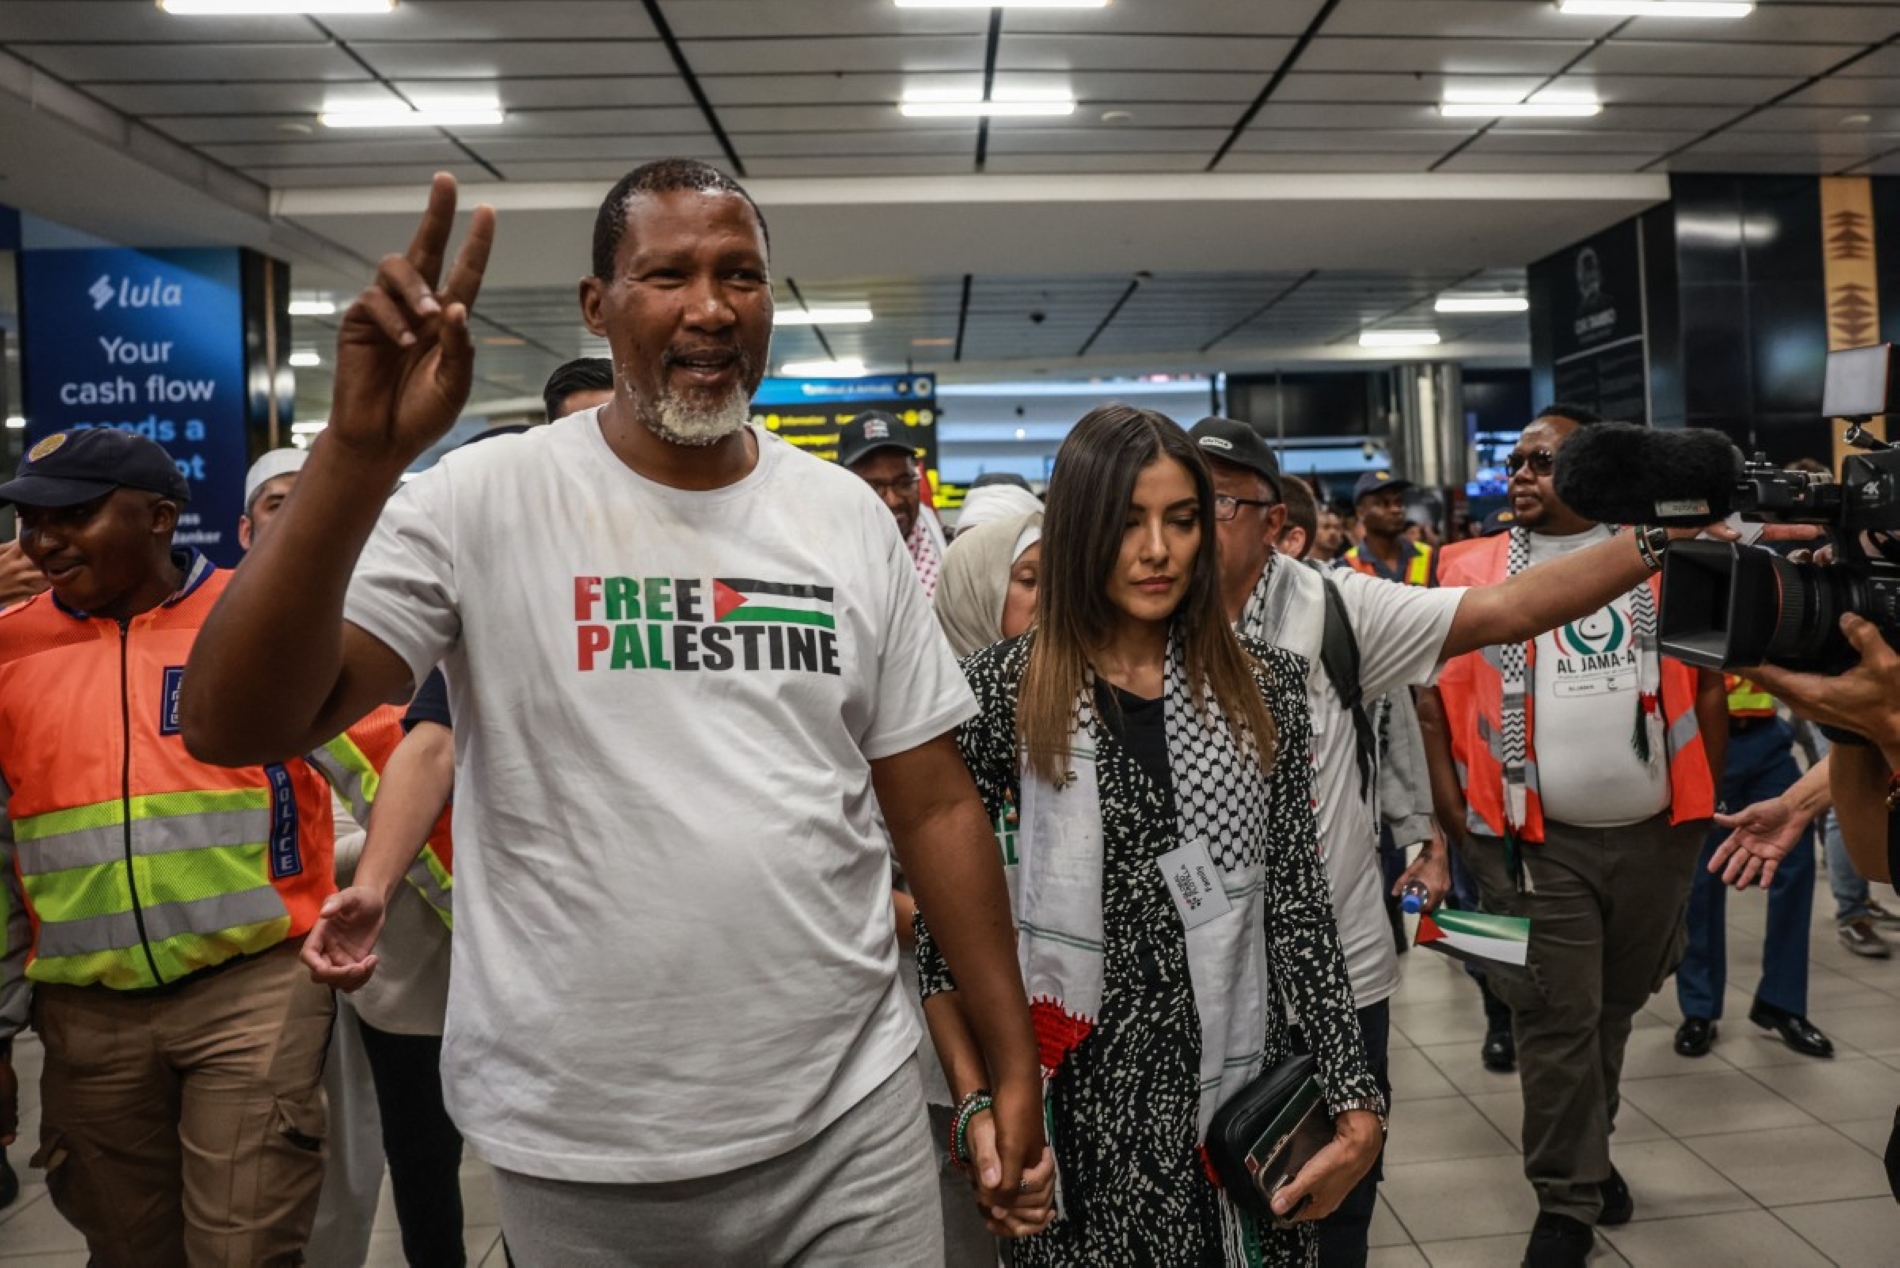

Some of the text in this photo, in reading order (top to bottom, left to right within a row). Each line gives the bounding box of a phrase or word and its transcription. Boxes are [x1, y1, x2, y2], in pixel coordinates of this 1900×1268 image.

[118, 277, 182, 307] lula
[99, 337, 172, 364] Your
[60, 375, 215, 405] cash flow
[185, 419, 205, 441] a
[1862, 481, 1880, 495] 4K
[574, 576, 704, 623] FREE
[577, 623, 841, 676] PALESTINE
[1557, 648, 1637, 674] AL JAMA-A
[276, 771, 293, 871] POLICE
